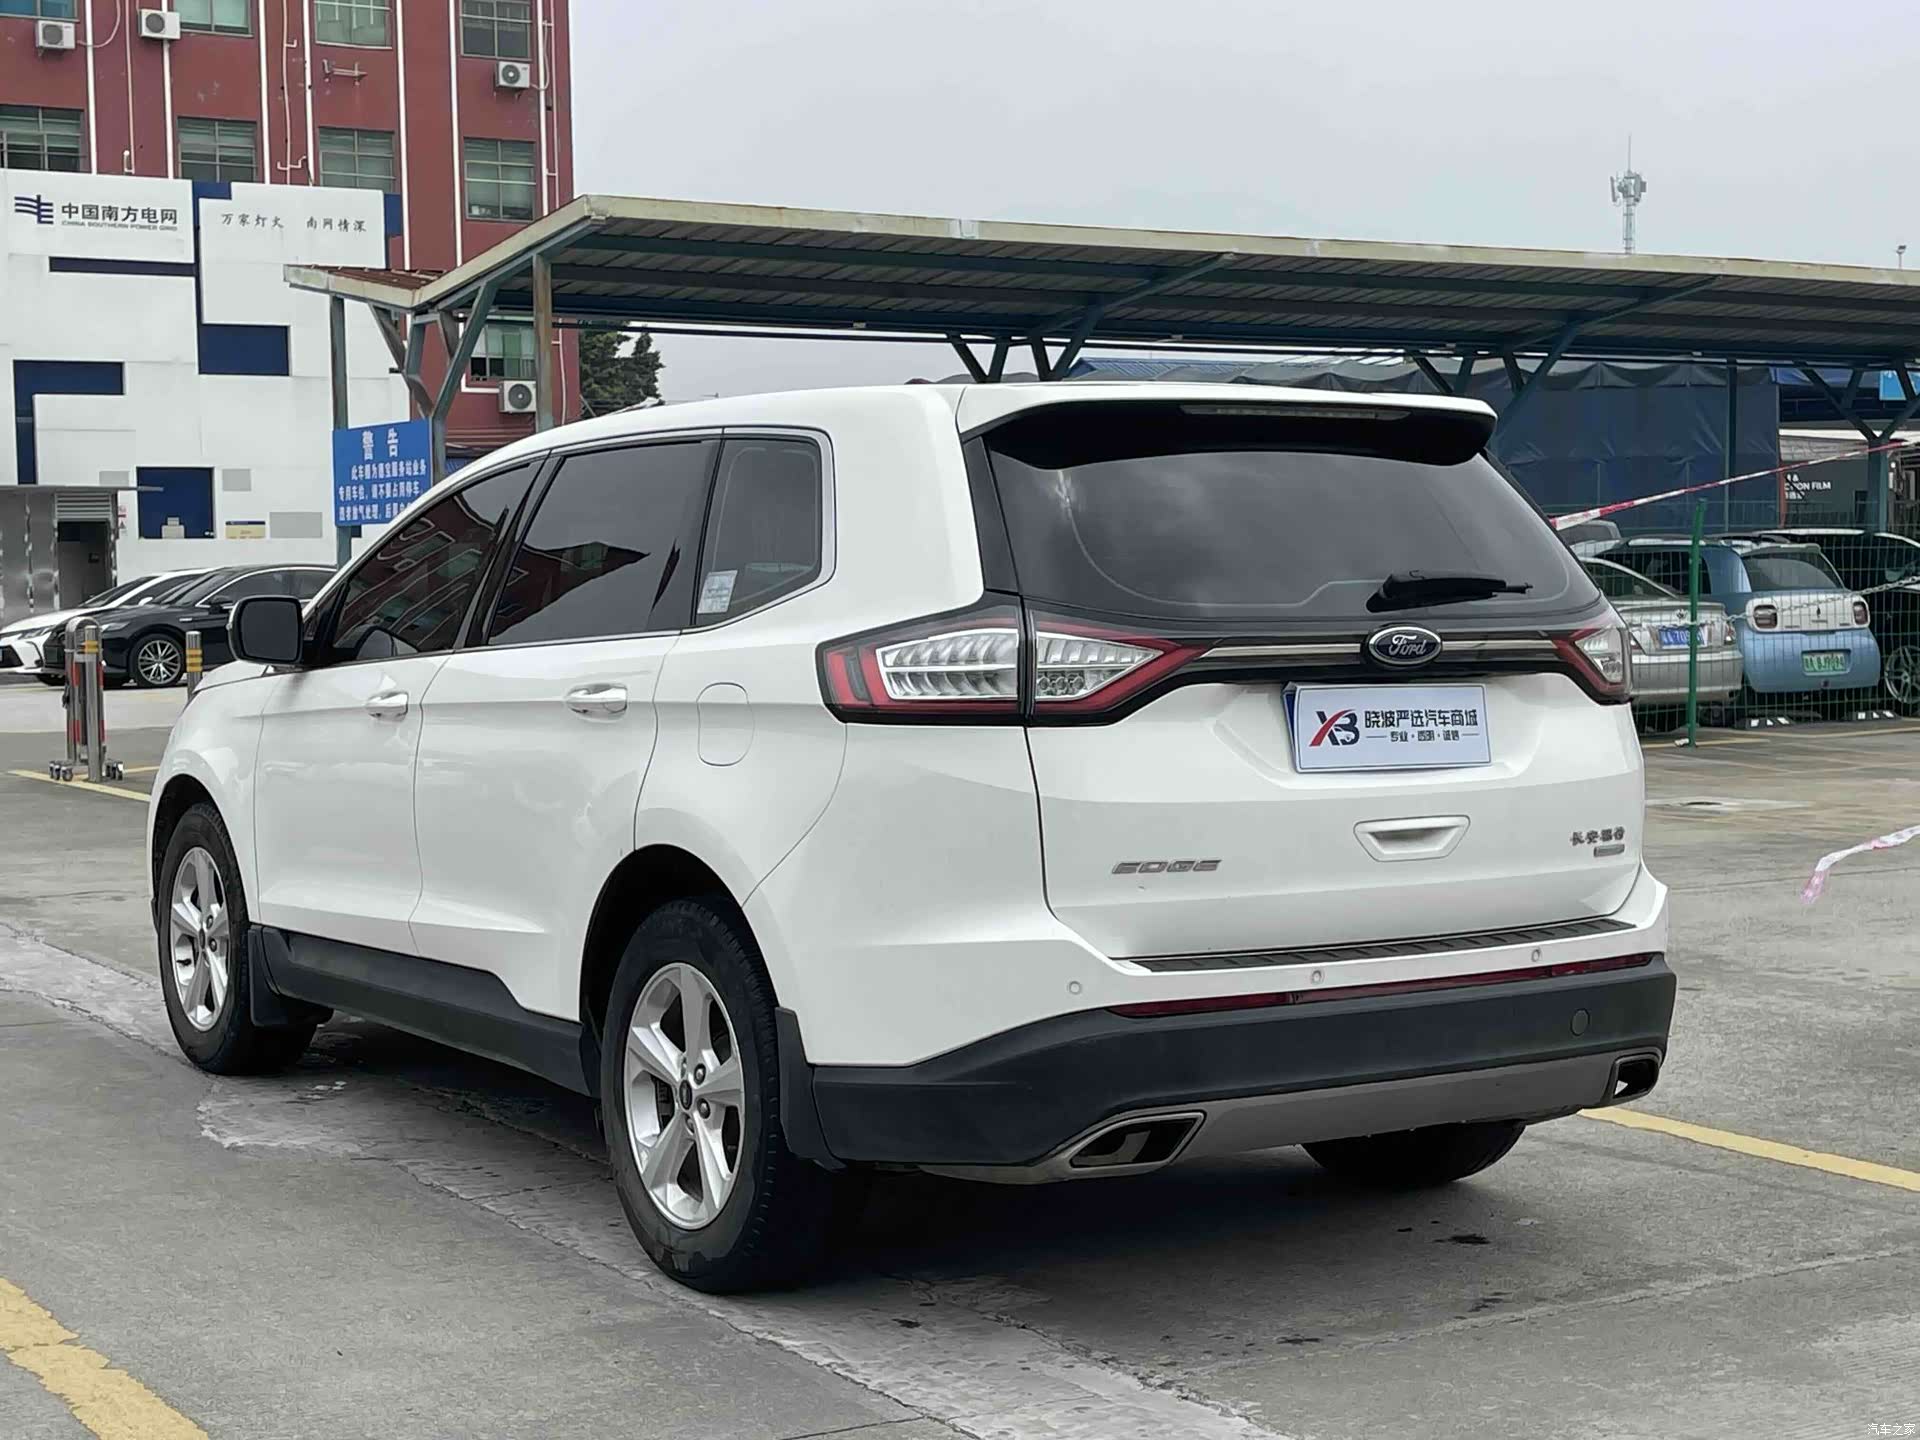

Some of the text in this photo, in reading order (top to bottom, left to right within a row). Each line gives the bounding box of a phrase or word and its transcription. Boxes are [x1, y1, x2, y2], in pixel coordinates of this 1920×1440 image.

[62, 202, 177, 224] 中国南方电网
[221, 213, 366, 232] 万家灯火 南网情深
[362, 427, 398, 460] 警告
[1811, 481, 1831, 490] FILM
[1388, 634, 1427, 656] Ford
[1364, 708, 1479, 729] 晓波严选汽车商城
[1111, 860, 1222, 874] EDGE
